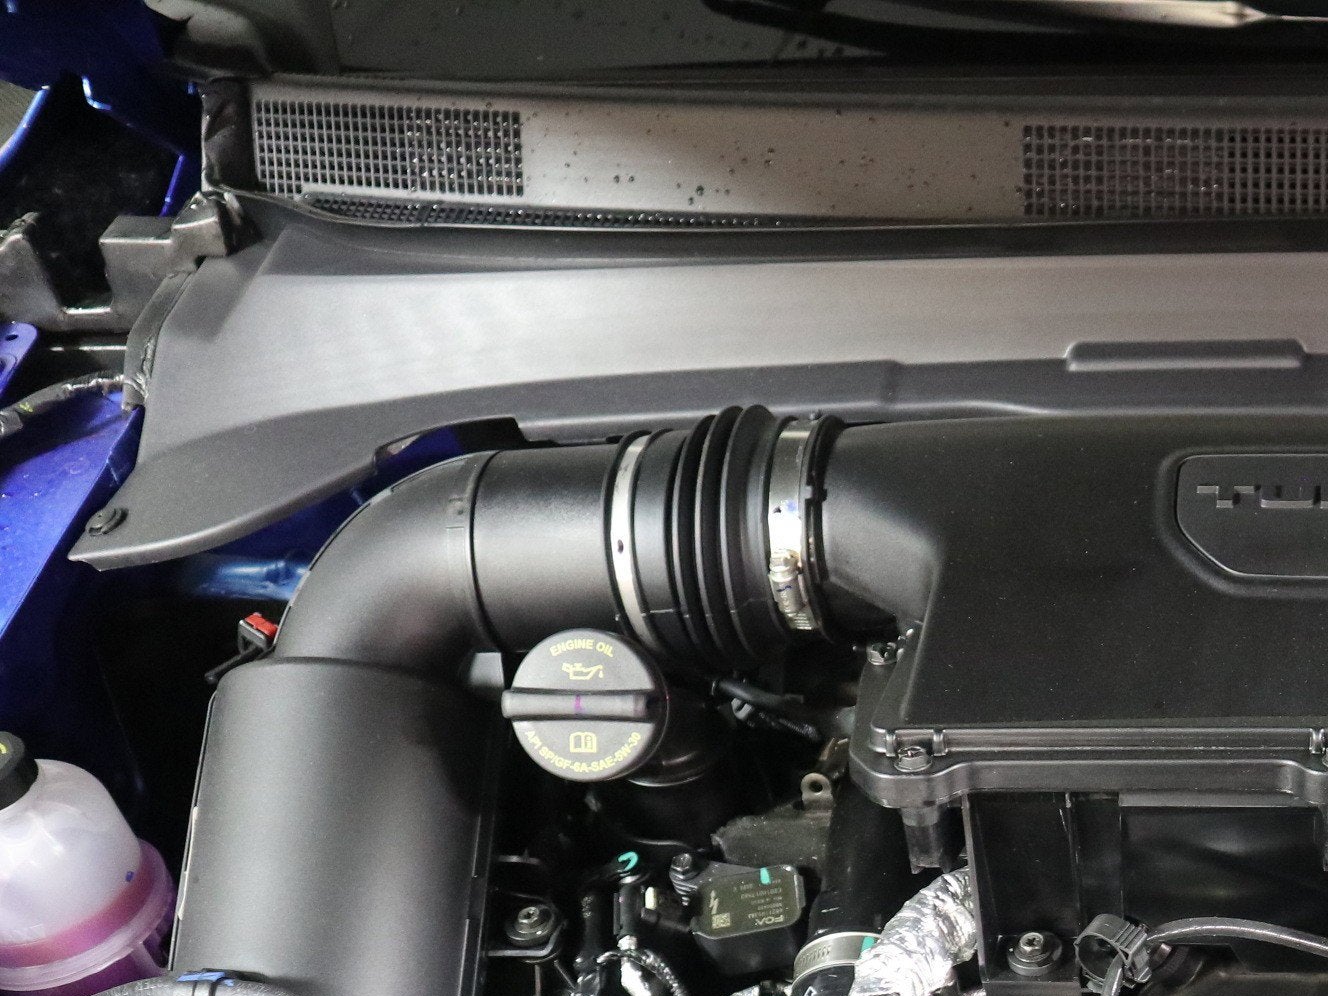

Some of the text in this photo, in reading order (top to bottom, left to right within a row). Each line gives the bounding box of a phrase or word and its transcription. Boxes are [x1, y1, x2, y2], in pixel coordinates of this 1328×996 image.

[549, 639, 614, 658] ENGINE OIL
[525, 730, 542, 750] API
